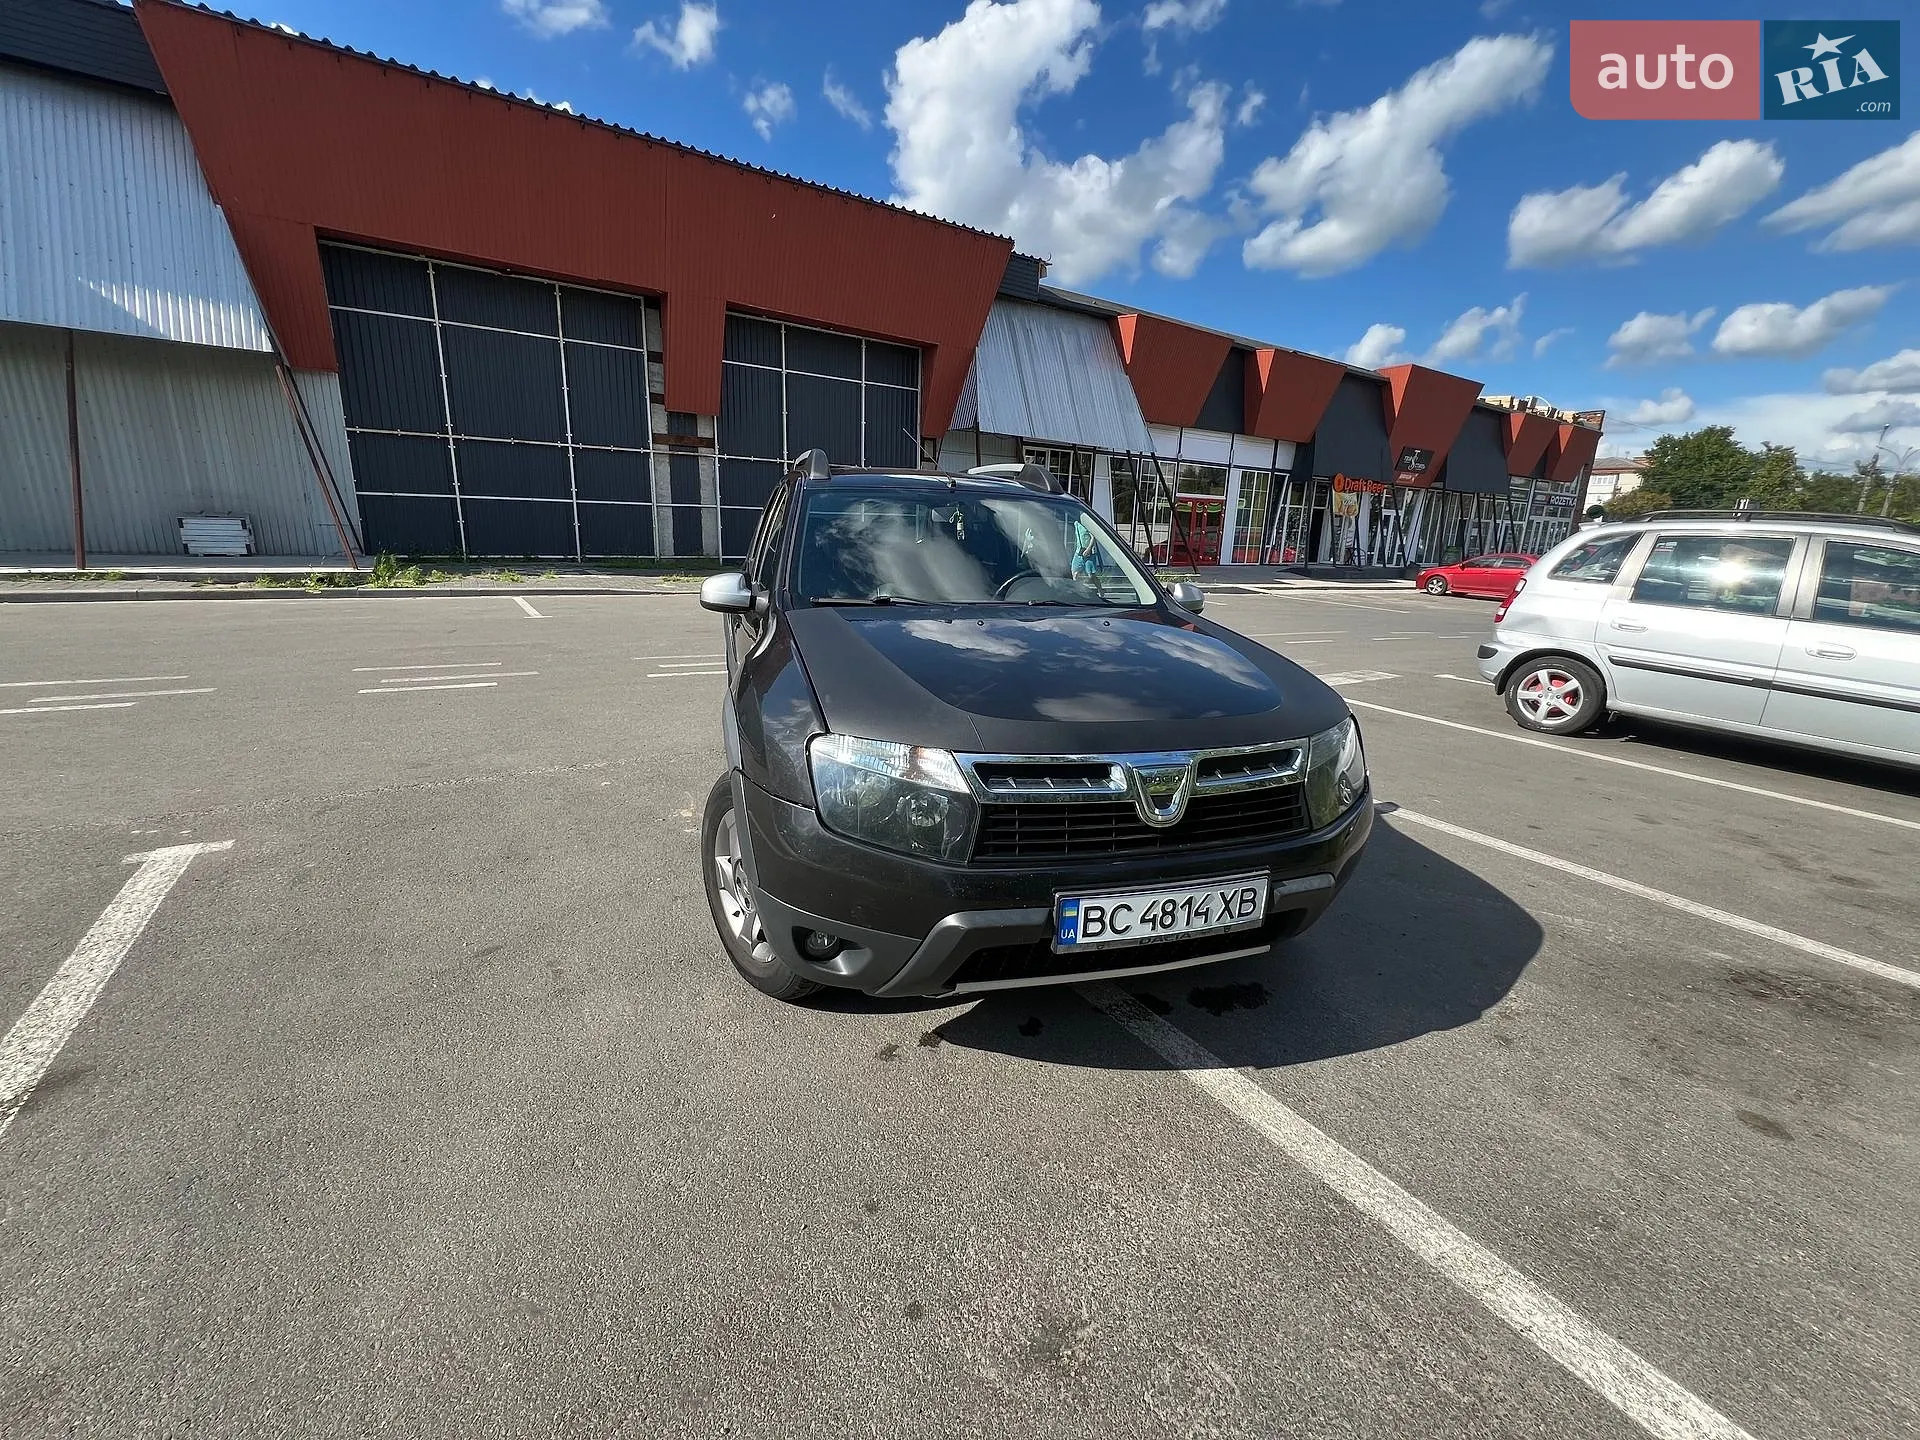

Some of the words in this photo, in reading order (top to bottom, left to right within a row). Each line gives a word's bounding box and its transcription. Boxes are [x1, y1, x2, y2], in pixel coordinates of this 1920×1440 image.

[1550, 495, 1577, 507] ROZETKA
[1082, 903, 1133, 938] BC
[1139, 893, 1210, 931] 4814
[1215, 887, 1257, 922] XB
[1061, 929, 1075, 940] UA
